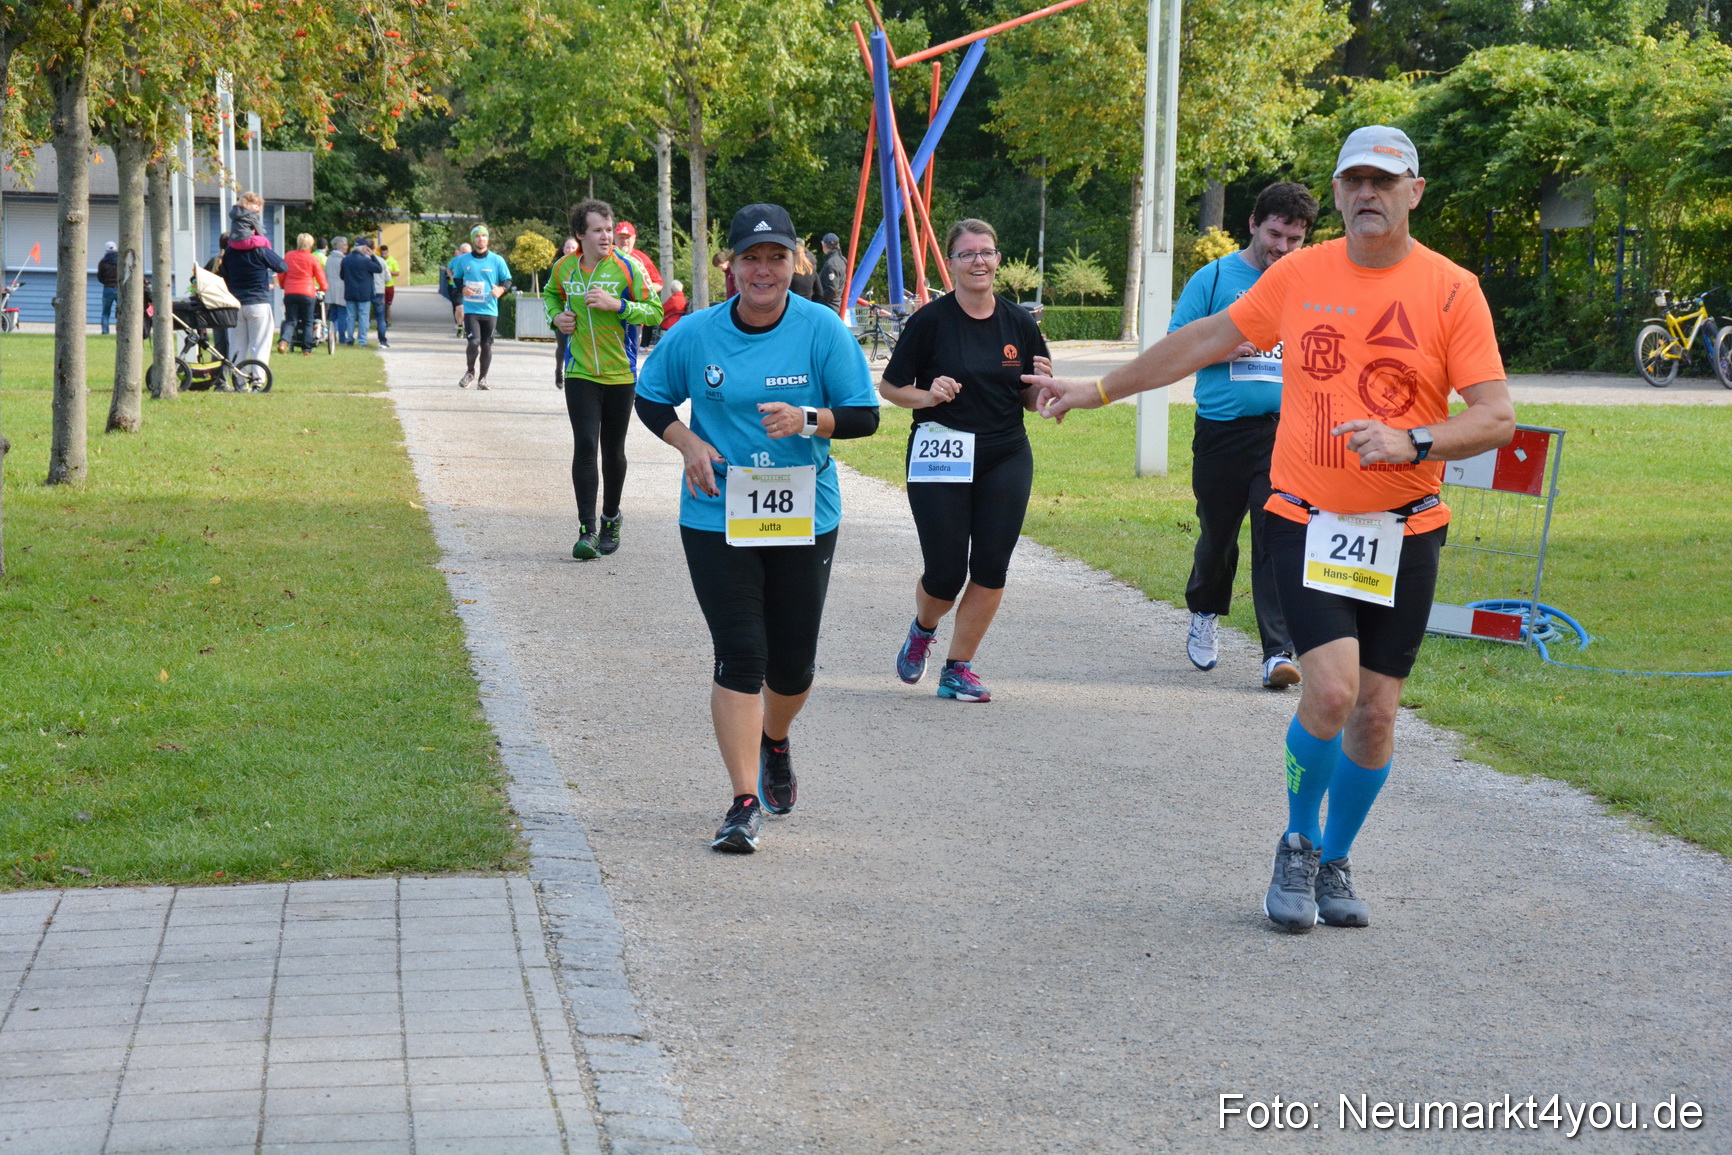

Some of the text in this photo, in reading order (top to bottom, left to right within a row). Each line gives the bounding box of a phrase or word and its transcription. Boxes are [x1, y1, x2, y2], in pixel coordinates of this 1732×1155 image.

[1442, 289, 1457, 312] Reebok
[1247, 363, 1276, 372] Christian
[765, 373, 809, 388] BOCK
[919, 439, 964, 458] 2343
[750, 451, 775, 468] 18.
[928, 464, 951, 472] Sandra
[747, 489, 794, 514] 148
[759, 522, 782, 532] Jutta
[1347, 517, 1383, 526] BOCK
[1329, 533, 1379, 565] 241
[1323, 567, 1380, 588] Hans-Günter
